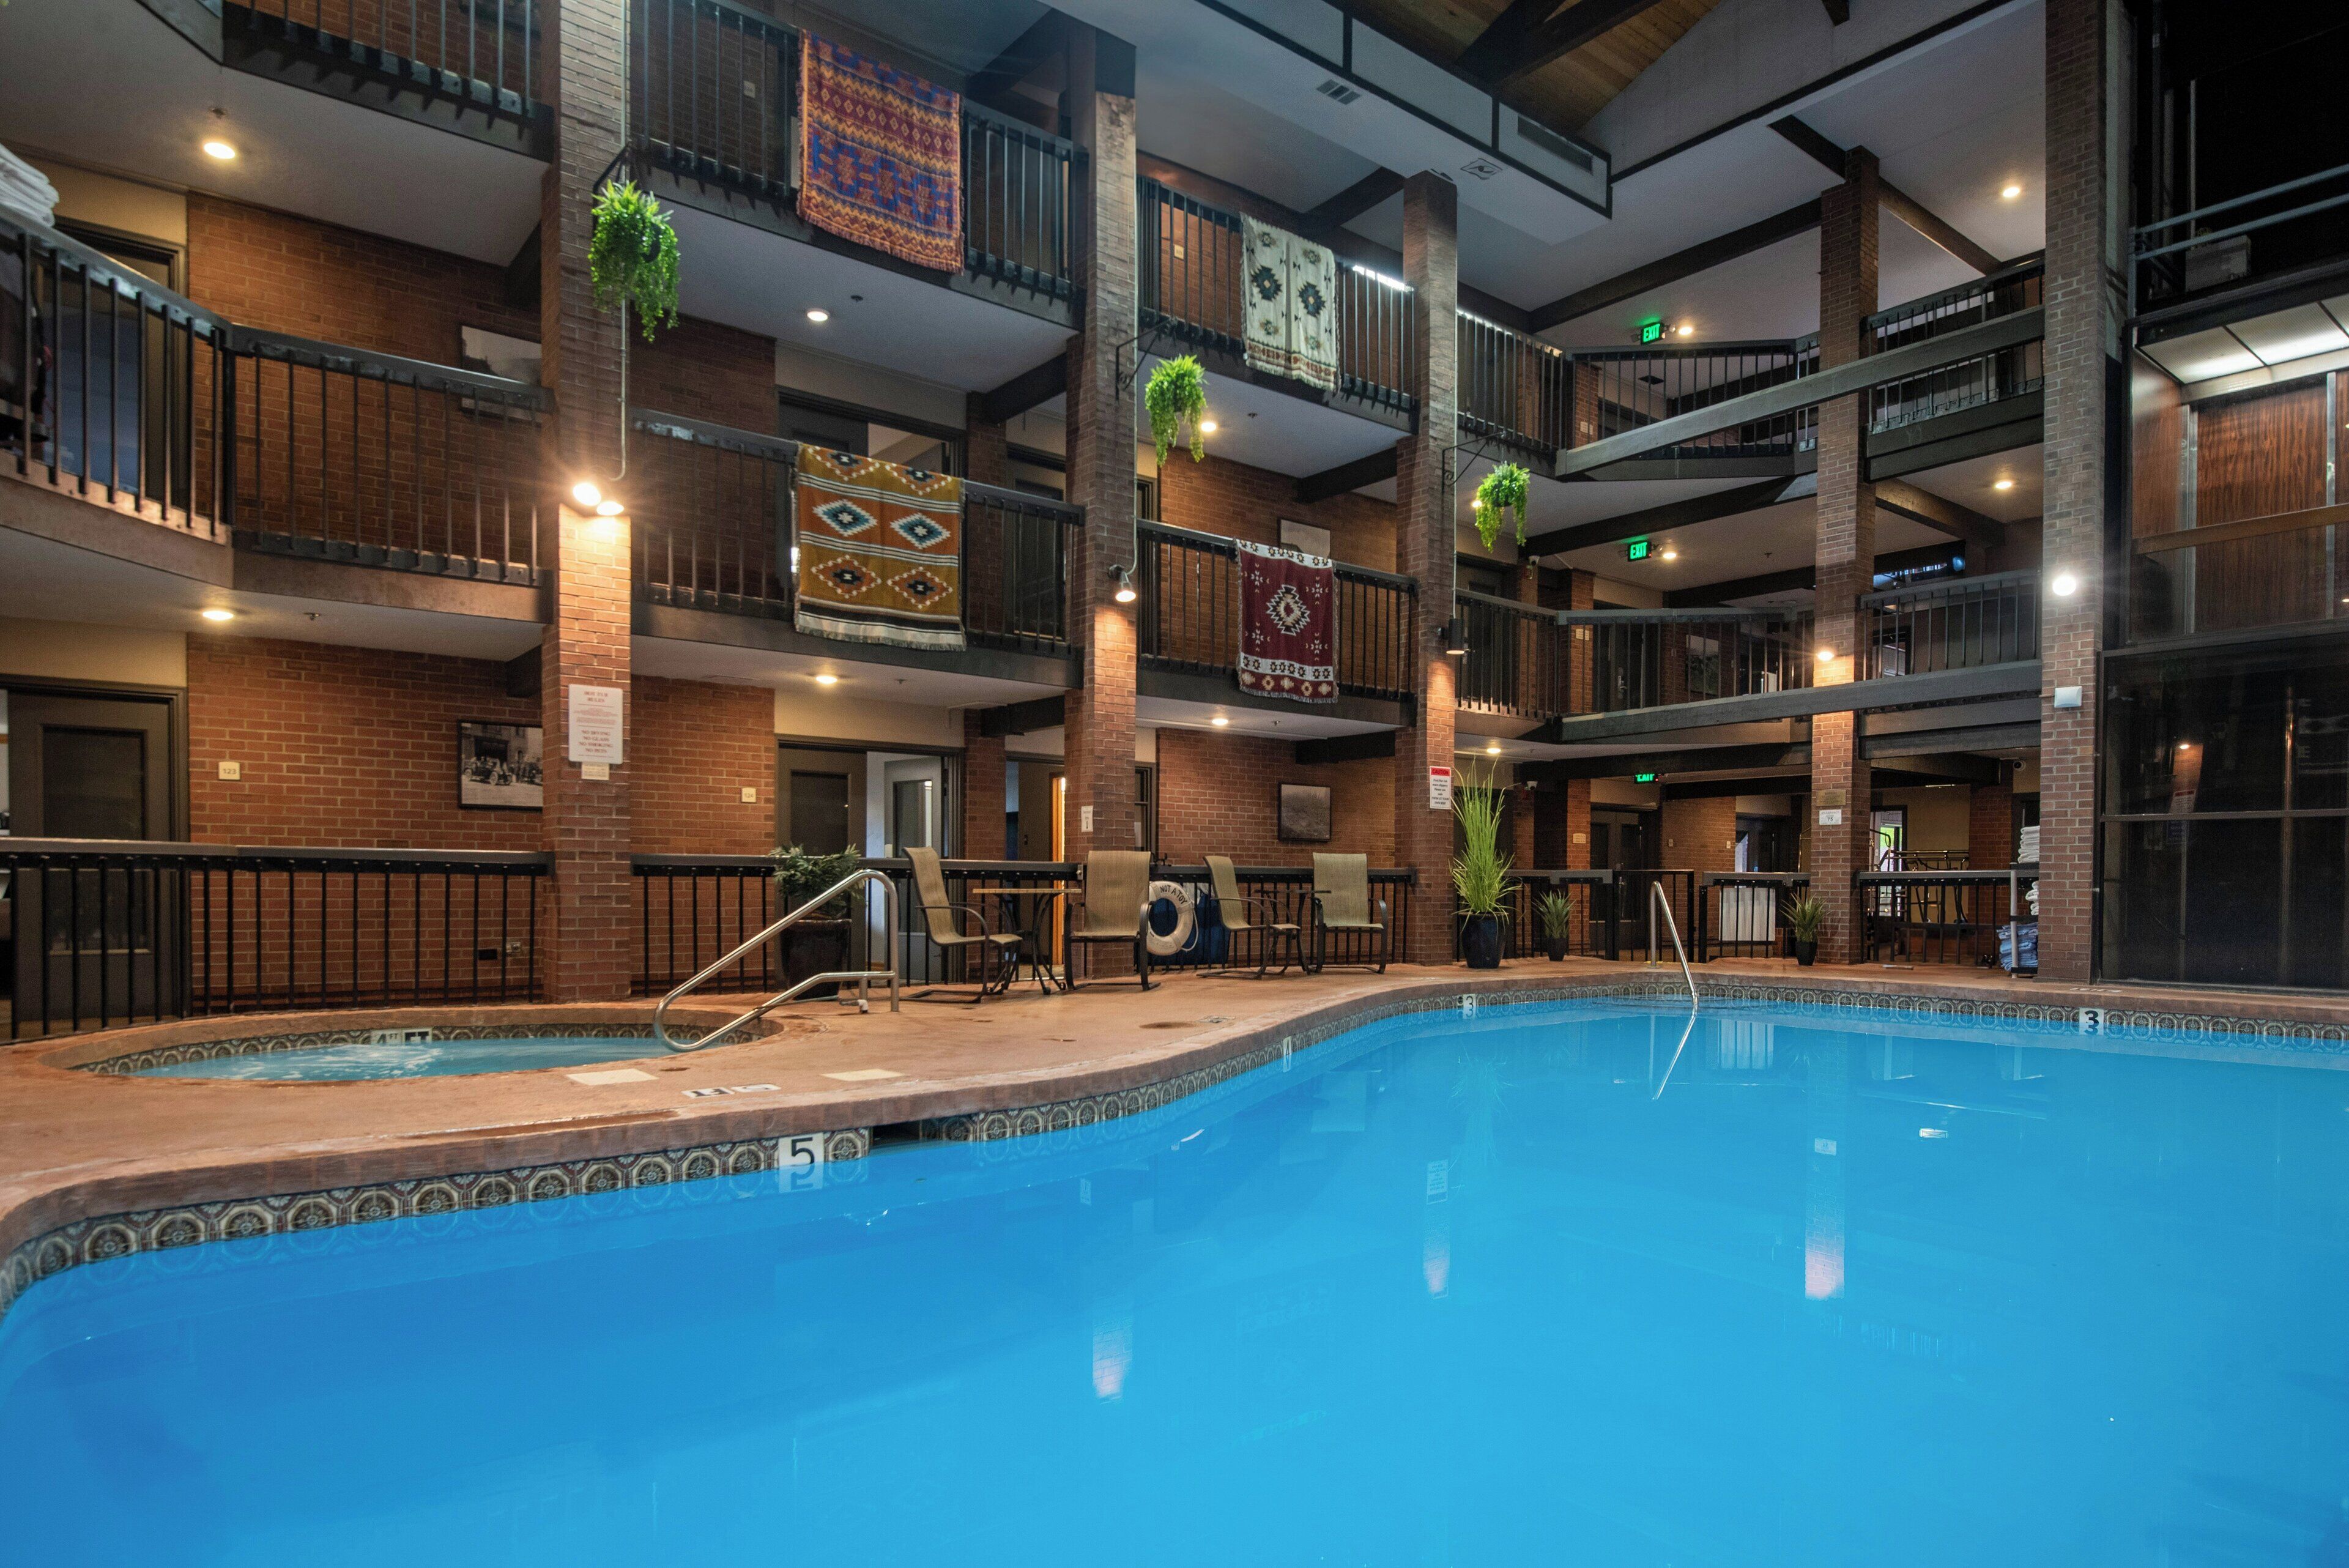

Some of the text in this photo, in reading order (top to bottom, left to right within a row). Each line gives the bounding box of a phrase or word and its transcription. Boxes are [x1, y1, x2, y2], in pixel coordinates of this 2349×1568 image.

[1643, 323, 1661, 343] EXIT
[1630, 541, 1648, 559] EXIT
[1159, 885, 1188, 905] NOT A TOY
[1466, 995, 1474, 1009] 3
[2084, 1010, 2099, 1024] 3
[791, 1137, 815, 1167] 5
